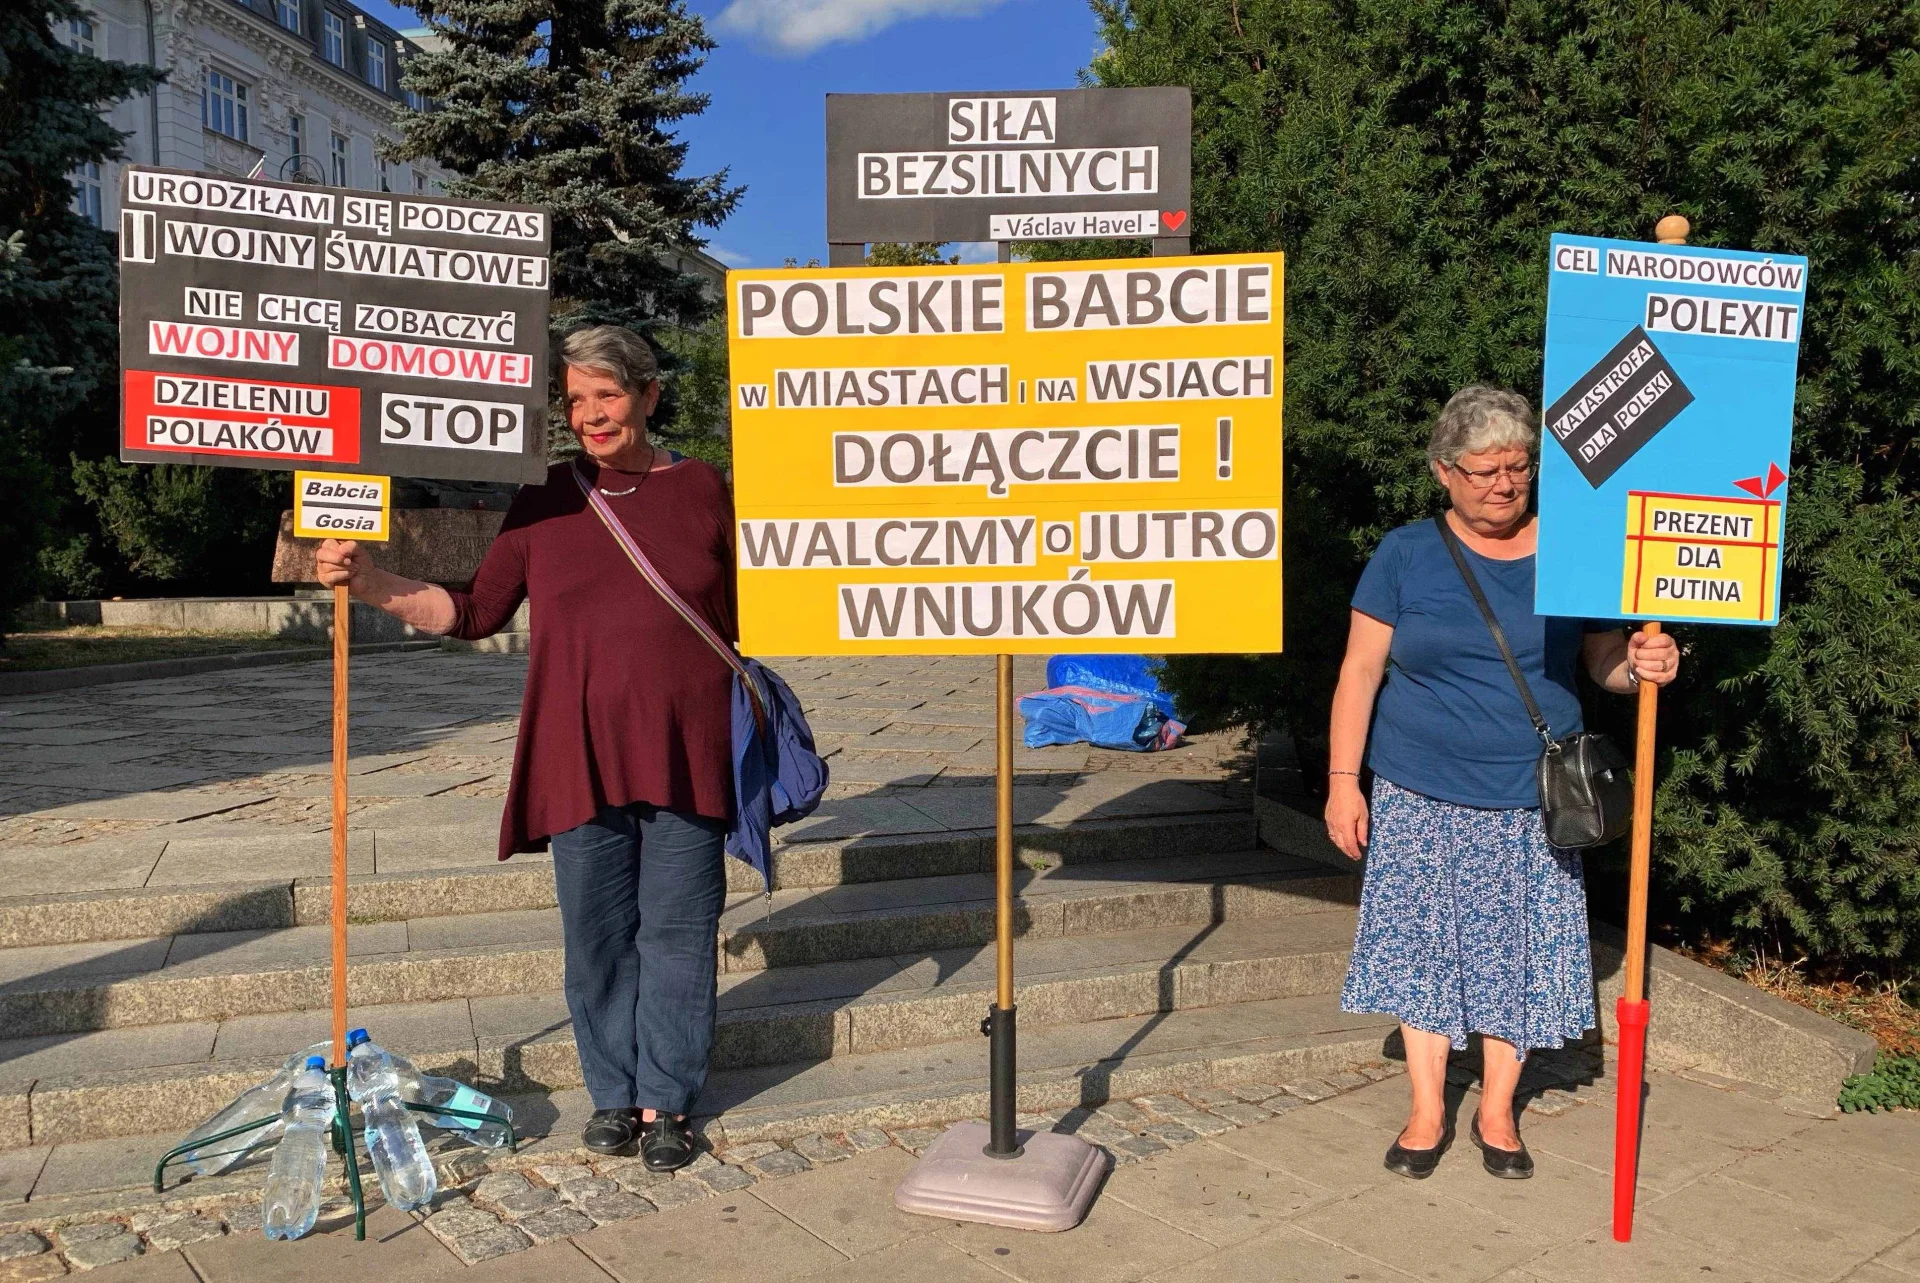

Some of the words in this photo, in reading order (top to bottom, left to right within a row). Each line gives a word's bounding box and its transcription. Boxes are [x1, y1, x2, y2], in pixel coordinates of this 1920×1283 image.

[950, 98, 1055, 142] SIŁA
[863, 151, 1153, 196] BEZSILNYCH
[133, 175, 330, 221] URODZIŁAM
[346, 201, 390, 232] SIĘ
[403, 206, 539, 238] PODCZAS
[1006, 215, 1077, 237] Václav
[1083, 214, 1143, 235] Havel
[123, 212, 154, 260] II
[167, 222, 313, 266] WOJNY
[326, 232, 548, 288] ŚWIATOWEJ
[1557, 248, 1597, 272] CEL
[1608, 253, 1802, 289] NARODOWCÓW
[188, 290, 240, 318] NIE
[260, 297, 340, 332] CHCĘ
[358, 305, 514, 343] ZOBACZYĆ
[742, 277, 1003, 336] POLSKIE
[1032, 266, 1269, 328] BABCIE
[1647, 296, 1797, 339] POLEXIT
[153, 323, 296, 362] WOJNY
[332, 339, 531, 384] DOMOWEJ
[156, 379, 328, 417] DZIELENIU
[741, 386, 767, 408] W
[777, 367, 1008, 406] MIASTACH
[1020, 382, 1024, 403] I
[1038, 379, 1076, 401] NA
[1089, 358, 1272, 400] WSIACH
[1554, 345, 1652, 438] KATASTROFA
[149, 419, 321, 453] POLAKÓW
[384, 399, 517, 447] STOP
[1582, 427, 1616, 461] DLA
[1616, 373, 1670, 428] POLSKI
[836, 429, 1178, 495] DOŁĄCZCIE
[305, 481, 379, 500] Babcia
[315, 514, 375, 531] Gosia
[740, 518, 1035, 567] WALCZMY
[1046, 524, 1072, 552] O
[1083, 511, 1276, 561] JUTRO
[1653, 511, 1753, 537] PREZENT
[1677, 547, 1721, 568] DLA
[841, 569, 1172, 637] WNUKÓW
[1655, 578, 1741, 602] PUTINA
